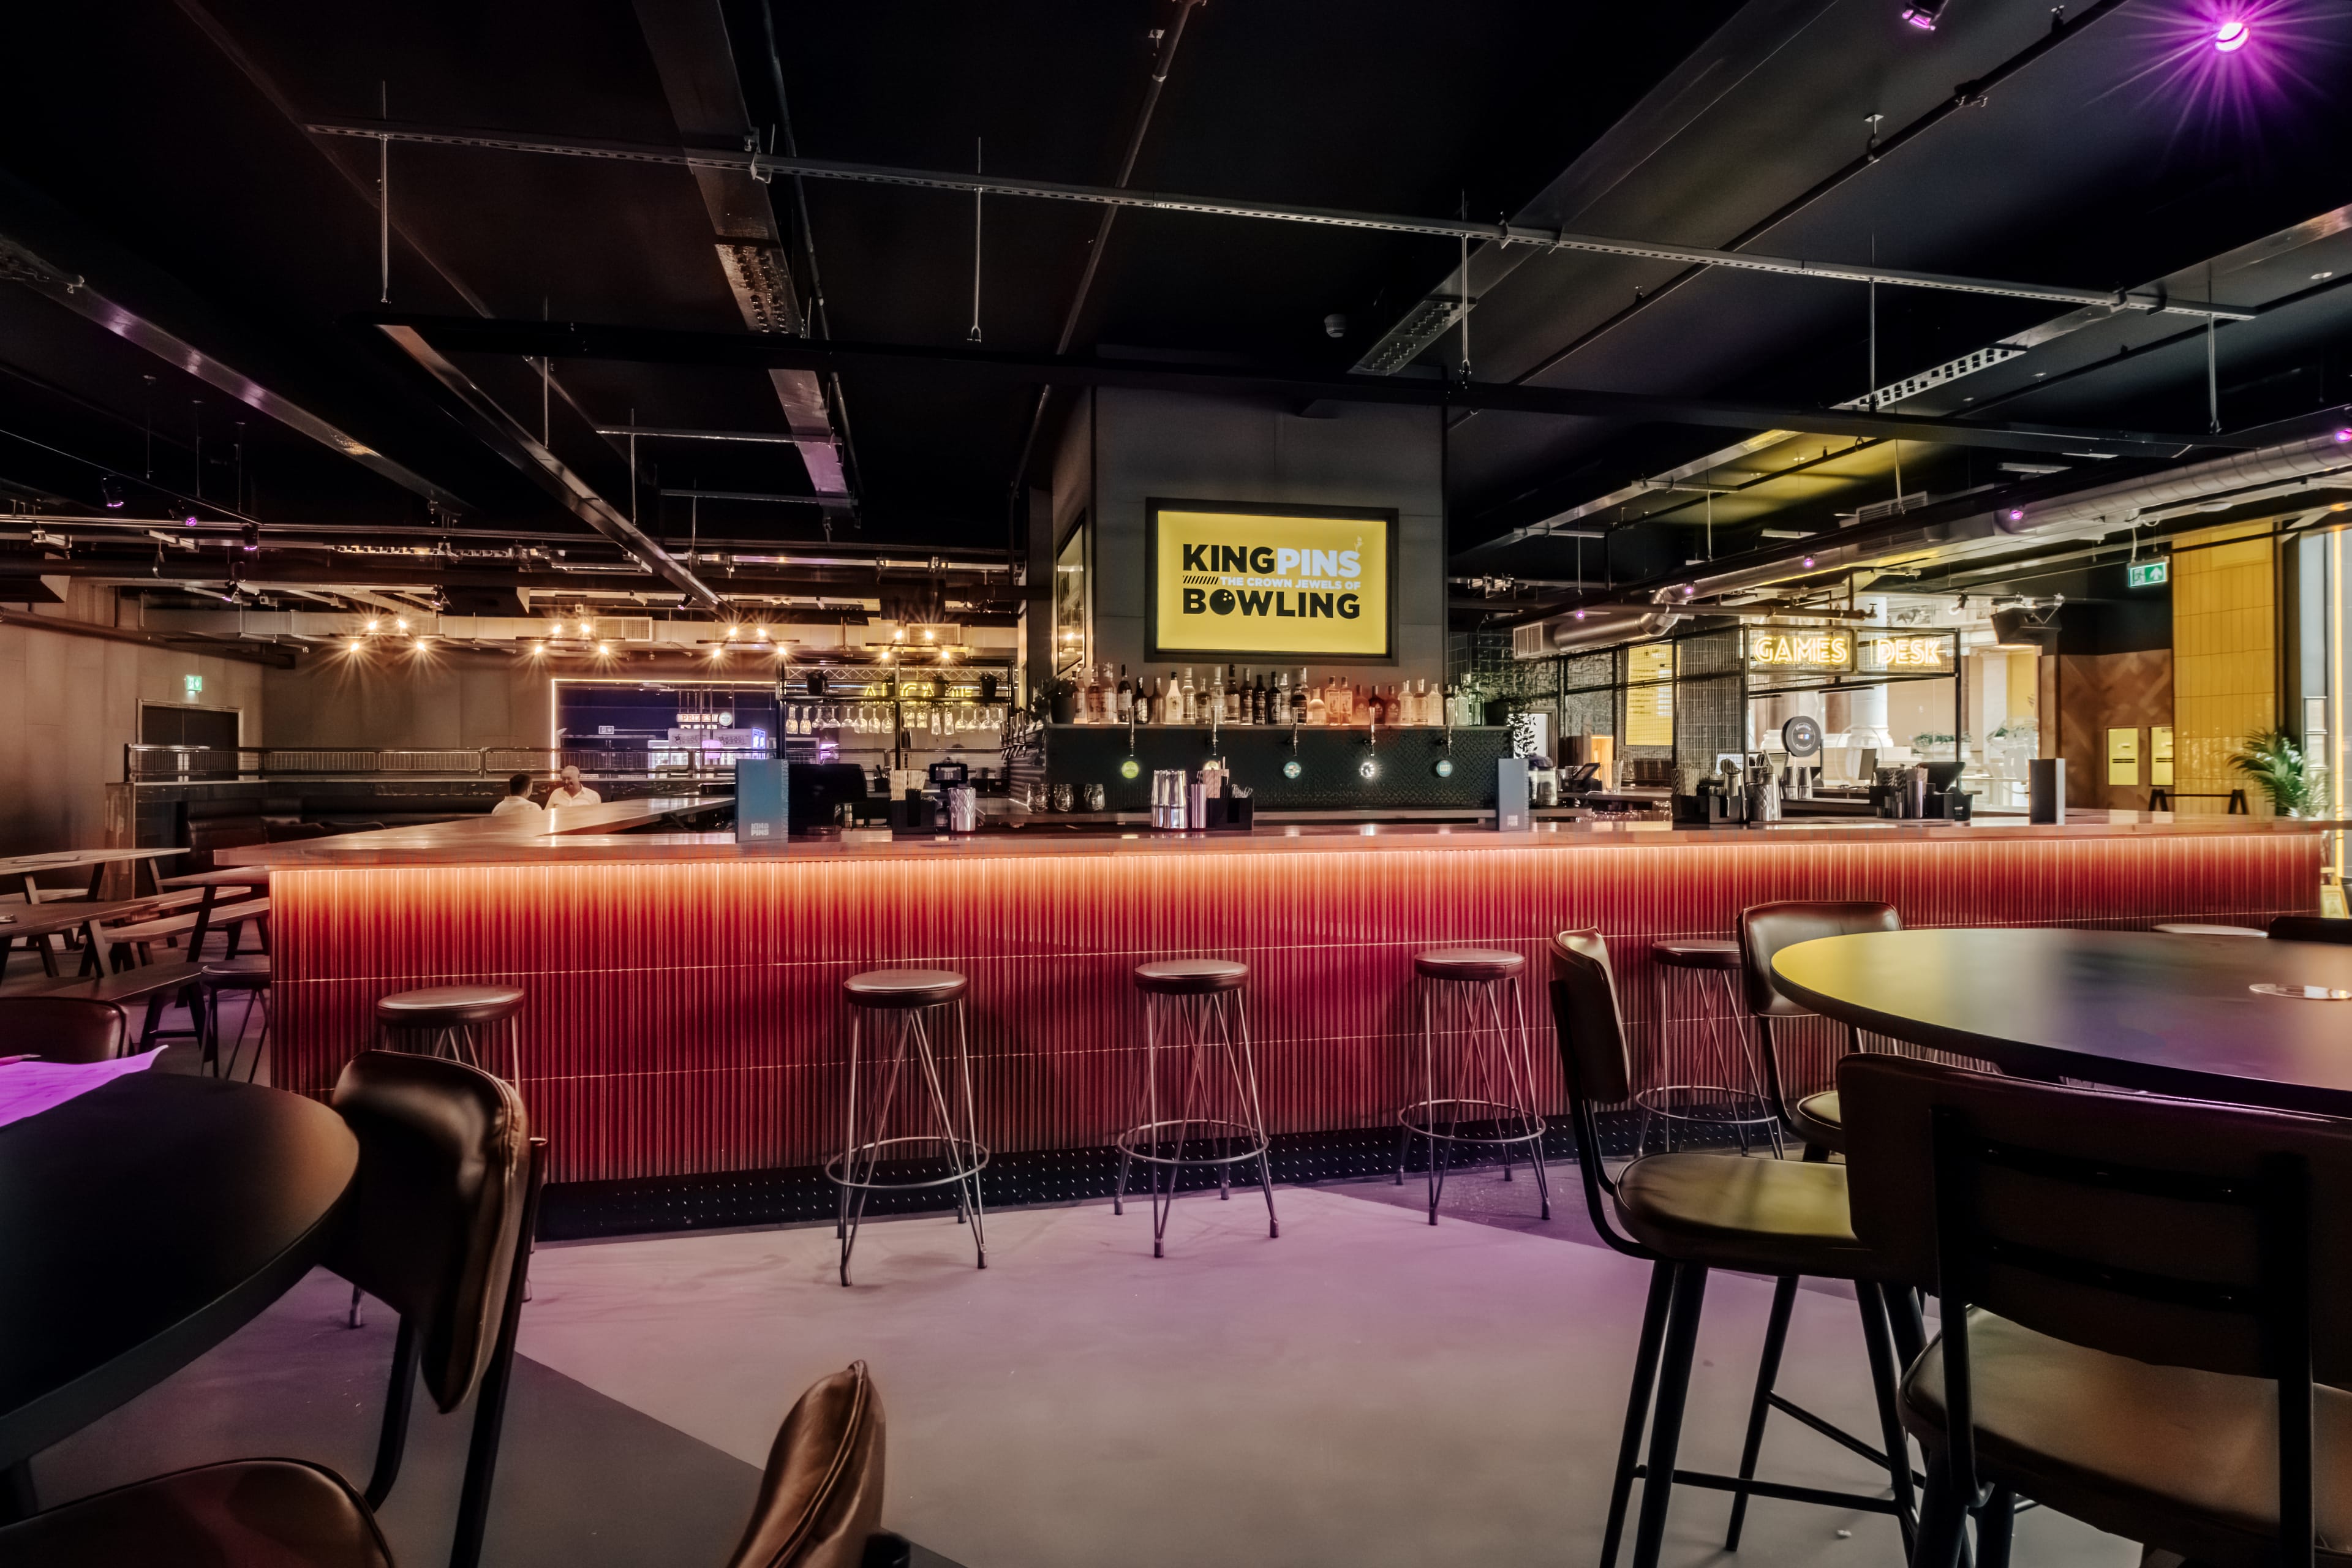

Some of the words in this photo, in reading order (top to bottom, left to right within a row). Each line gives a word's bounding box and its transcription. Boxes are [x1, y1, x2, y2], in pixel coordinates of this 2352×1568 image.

[1183, 544, 1361, 578] KINGPINS
[1219, 576, 1244, 586] THE
[1246, 578, 1292, 588] CROWN
[1295, 580, 1342, 590] JEWELS
[1345, 581, 1361, 590] OF
[1183, 588, 1360, 619] BOWLING
[1754, 636, 1849, 664] GAMES
[1876, 638, 1941, 665] DESK
